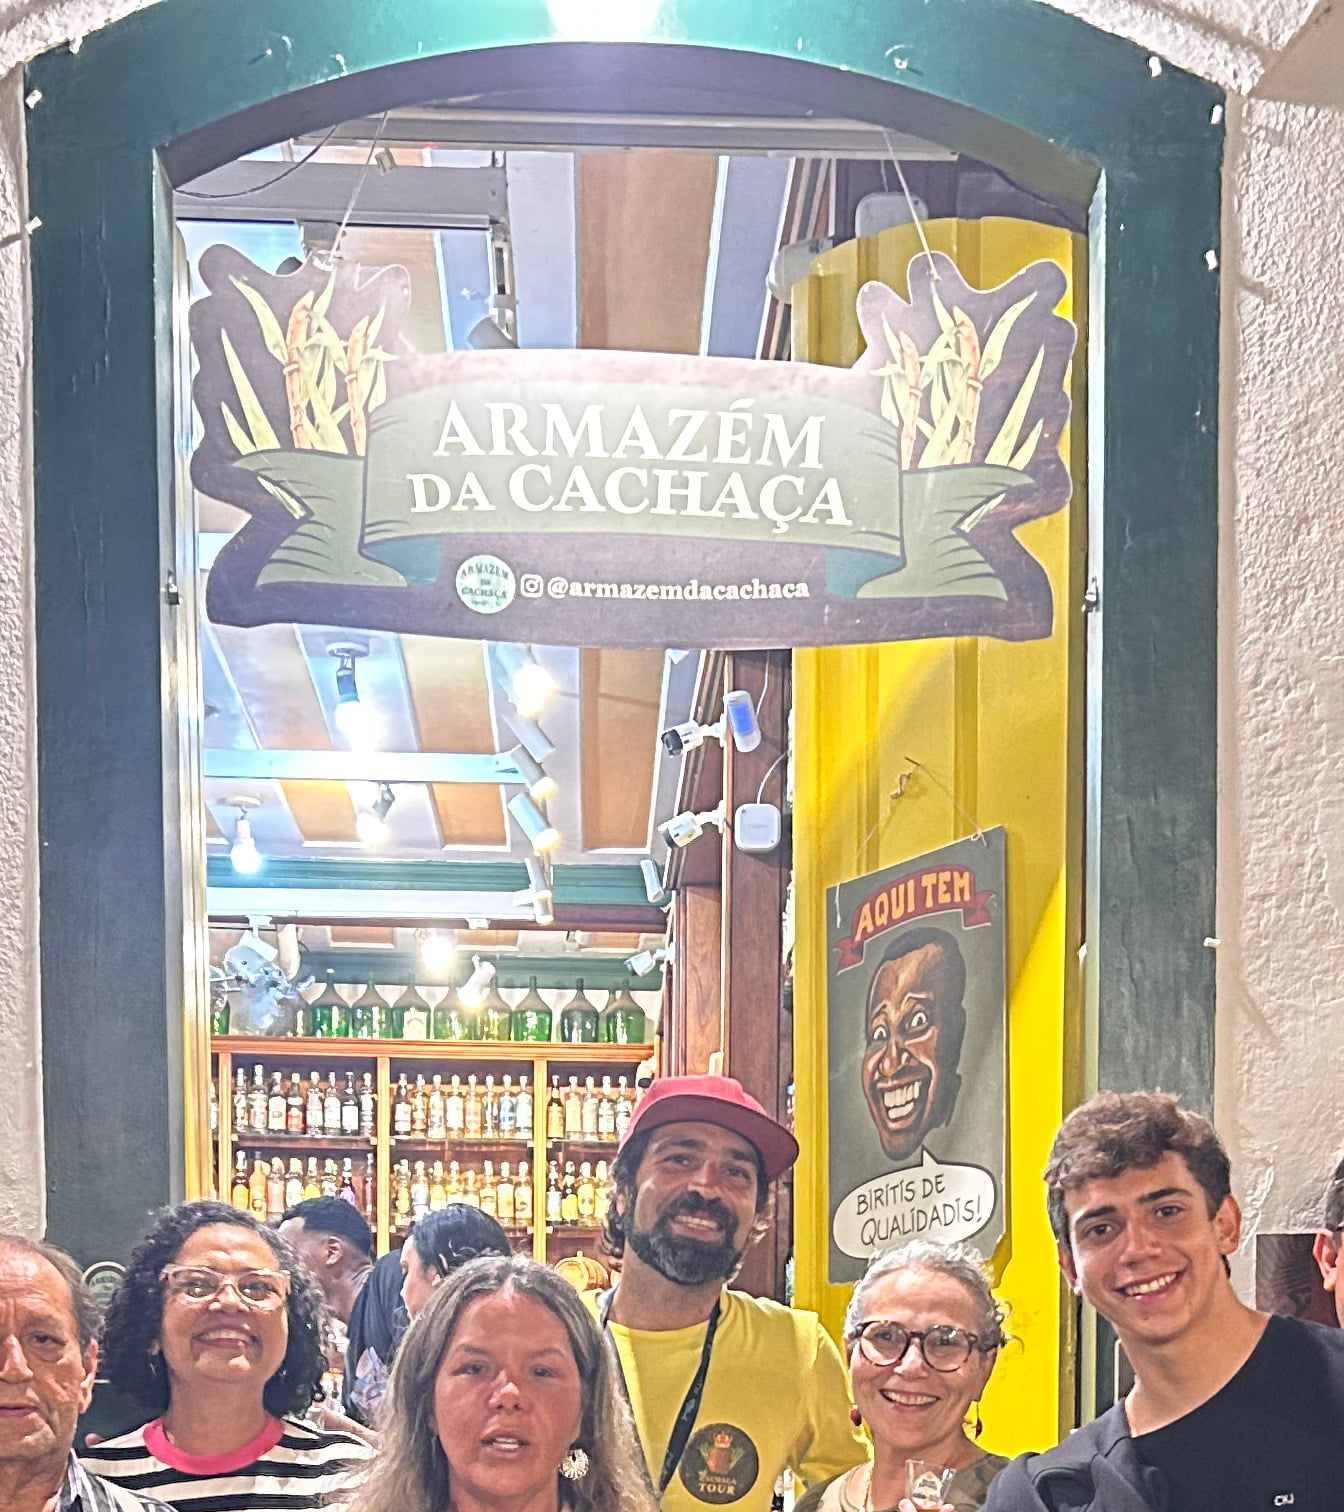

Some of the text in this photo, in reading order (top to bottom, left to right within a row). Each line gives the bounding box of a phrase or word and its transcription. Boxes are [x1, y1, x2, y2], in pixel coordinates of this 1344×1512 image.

[433, 398, 825, 469] ARMAZÉM
[406, 463, 854, 534] DA CACHAÇA
[547, 576, 810, 601] @armazemdacachaca
[854, 870, 971, 942] AQUI TEM
[921, 1173, 946, 1199] DE
